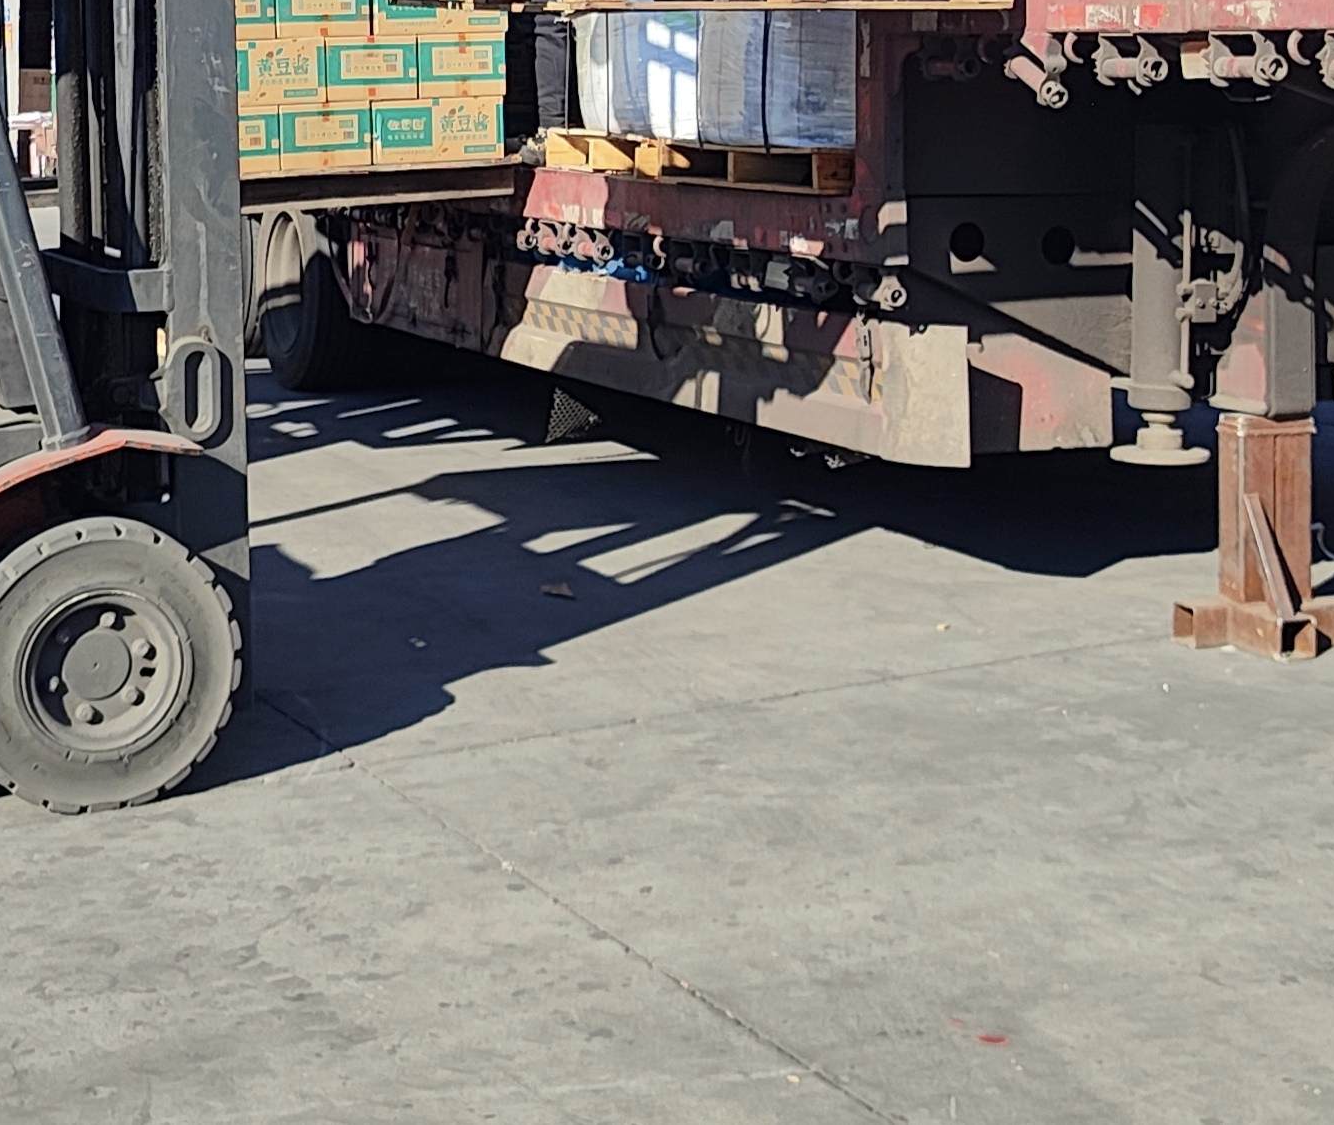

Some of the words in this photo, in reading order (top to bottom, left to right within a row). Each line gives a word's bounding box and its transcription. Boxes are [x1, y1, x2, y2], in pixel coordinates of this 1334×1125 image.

[257, 53, 310, 77] 黄豆酱
[440, 110, 490, 134] 黄豆酱
